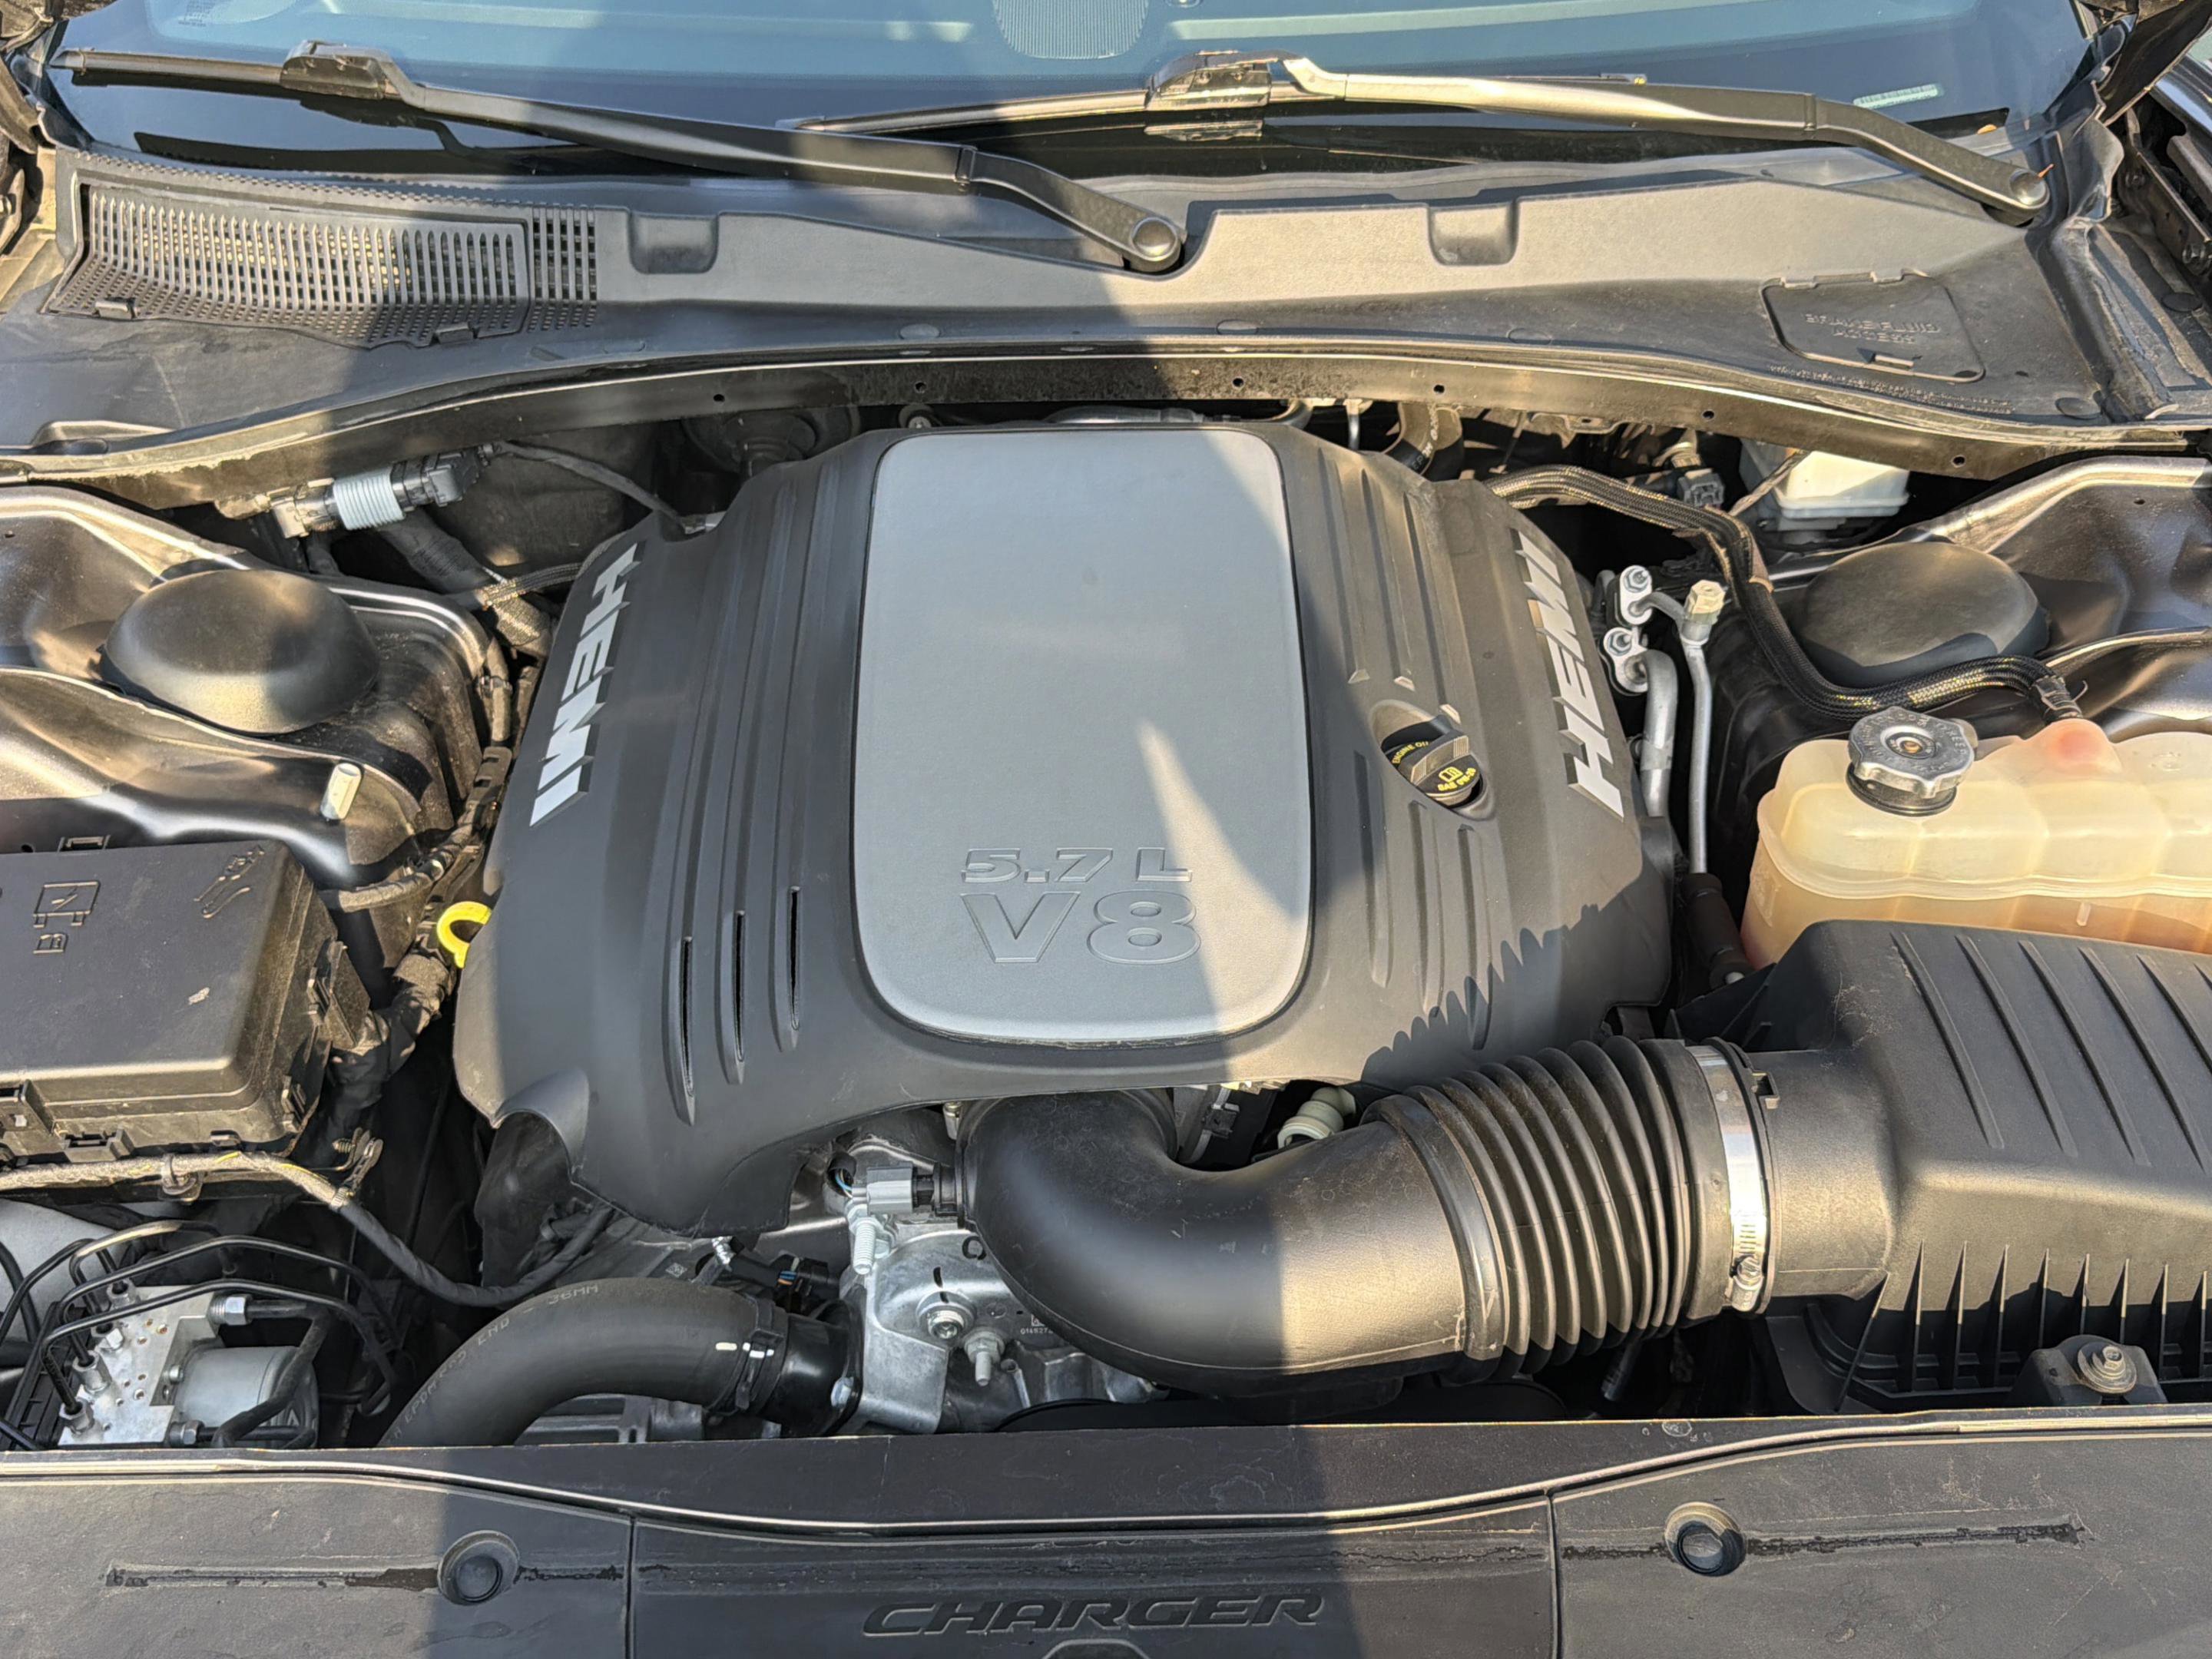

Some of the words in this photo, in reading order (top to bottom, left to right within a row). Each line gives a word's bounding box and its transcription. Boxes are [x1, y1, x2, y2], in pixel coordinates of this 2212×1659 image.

[1879, 321, 1942, 334] FLUID
[529, 542, 641, 827] HEMI
[1511, 528, 1624, 820] HEMI
[1391, 743, 1416, 764] ENGINE
[1437, 781, 1458, 791] SAE
[961, 847, 1114, 882] 5.7
[960, 889, 1202, 965] V8
[548, 1284, 599, 1305] 36MM
[862, 1594, 1326, 1637] CHARGER
